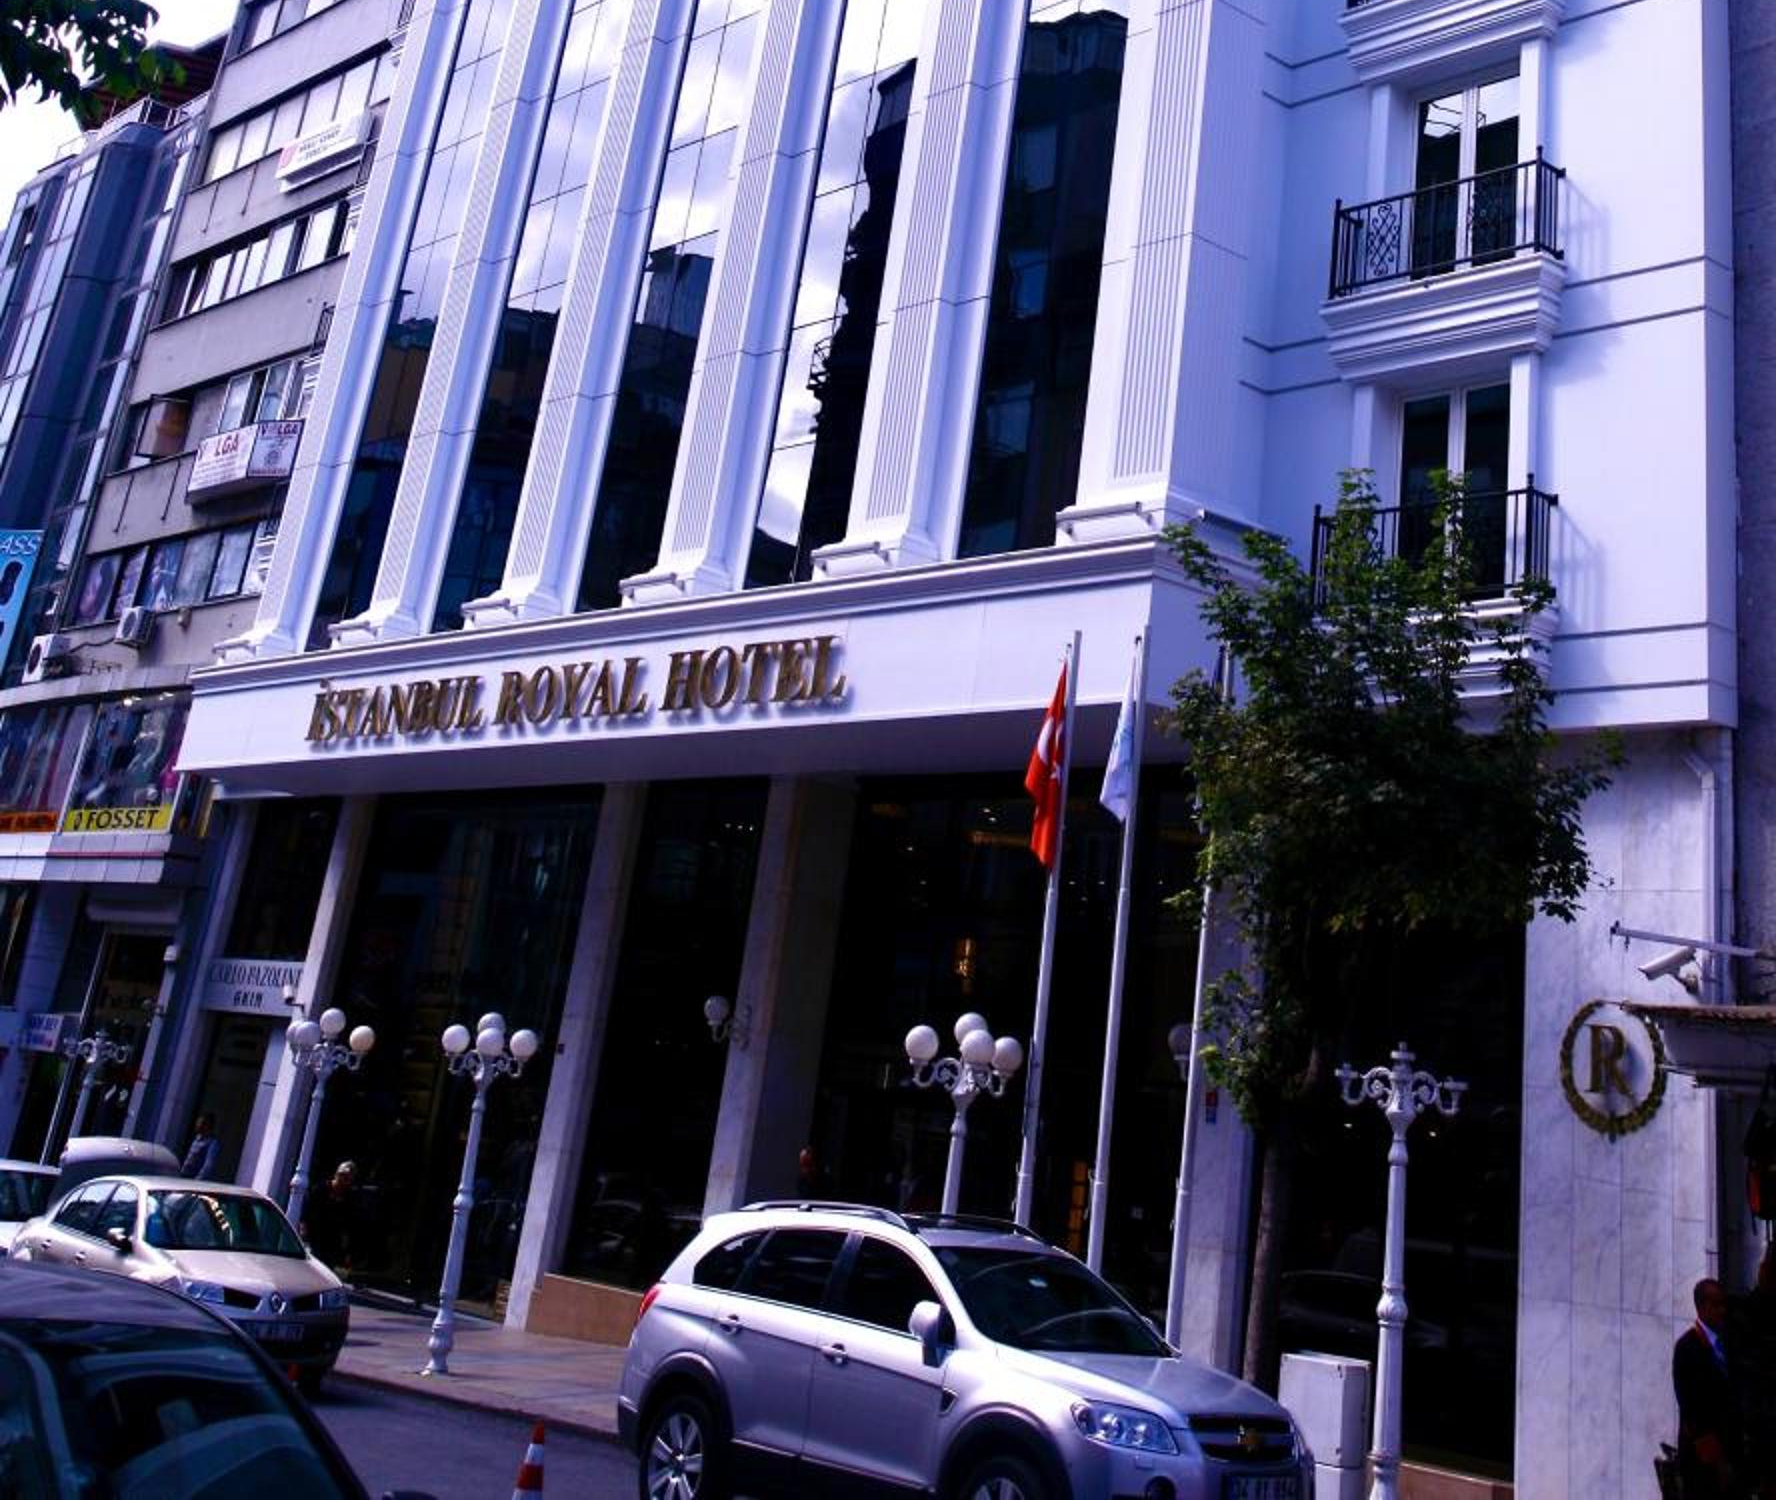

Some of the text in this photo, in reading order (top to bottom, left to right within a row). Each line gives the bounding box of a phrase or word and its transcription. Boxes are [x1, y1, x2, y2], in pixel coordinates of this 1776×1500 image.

[304, 635, 847, 741] İSTANBUL ROYAL HOTEL
[86, 809, 159, 830] FOSSET
[1583, 1023, 1635, 1098] R
